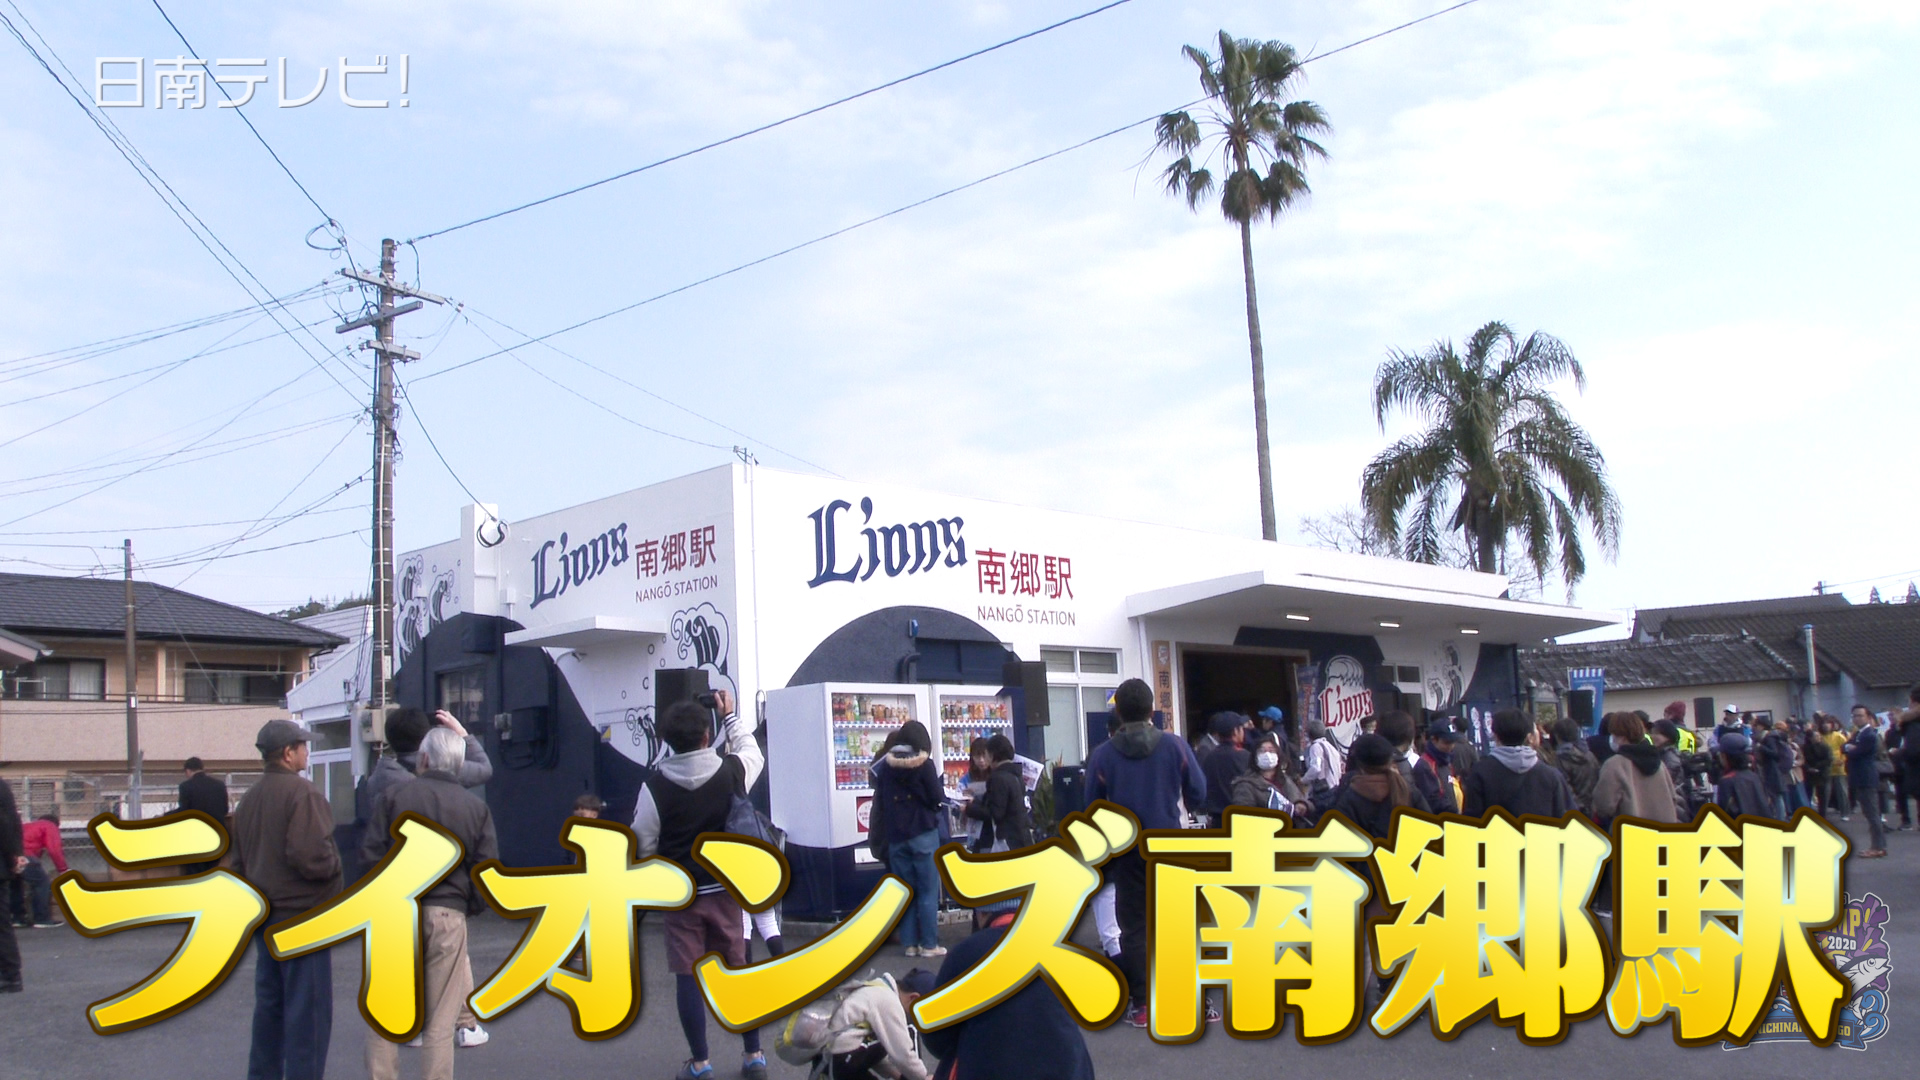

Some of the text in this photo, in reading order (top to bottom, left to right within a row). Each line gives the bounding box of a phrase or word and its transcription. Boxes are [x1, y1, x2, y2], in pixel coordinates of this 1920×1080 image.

[634, 525, 717, 580] 南郷駅
[674, 575, 718, 597] STATION
[975, 547, 1074, 600] 南郷駅
[1027, 608, 1076, 626] STATION
